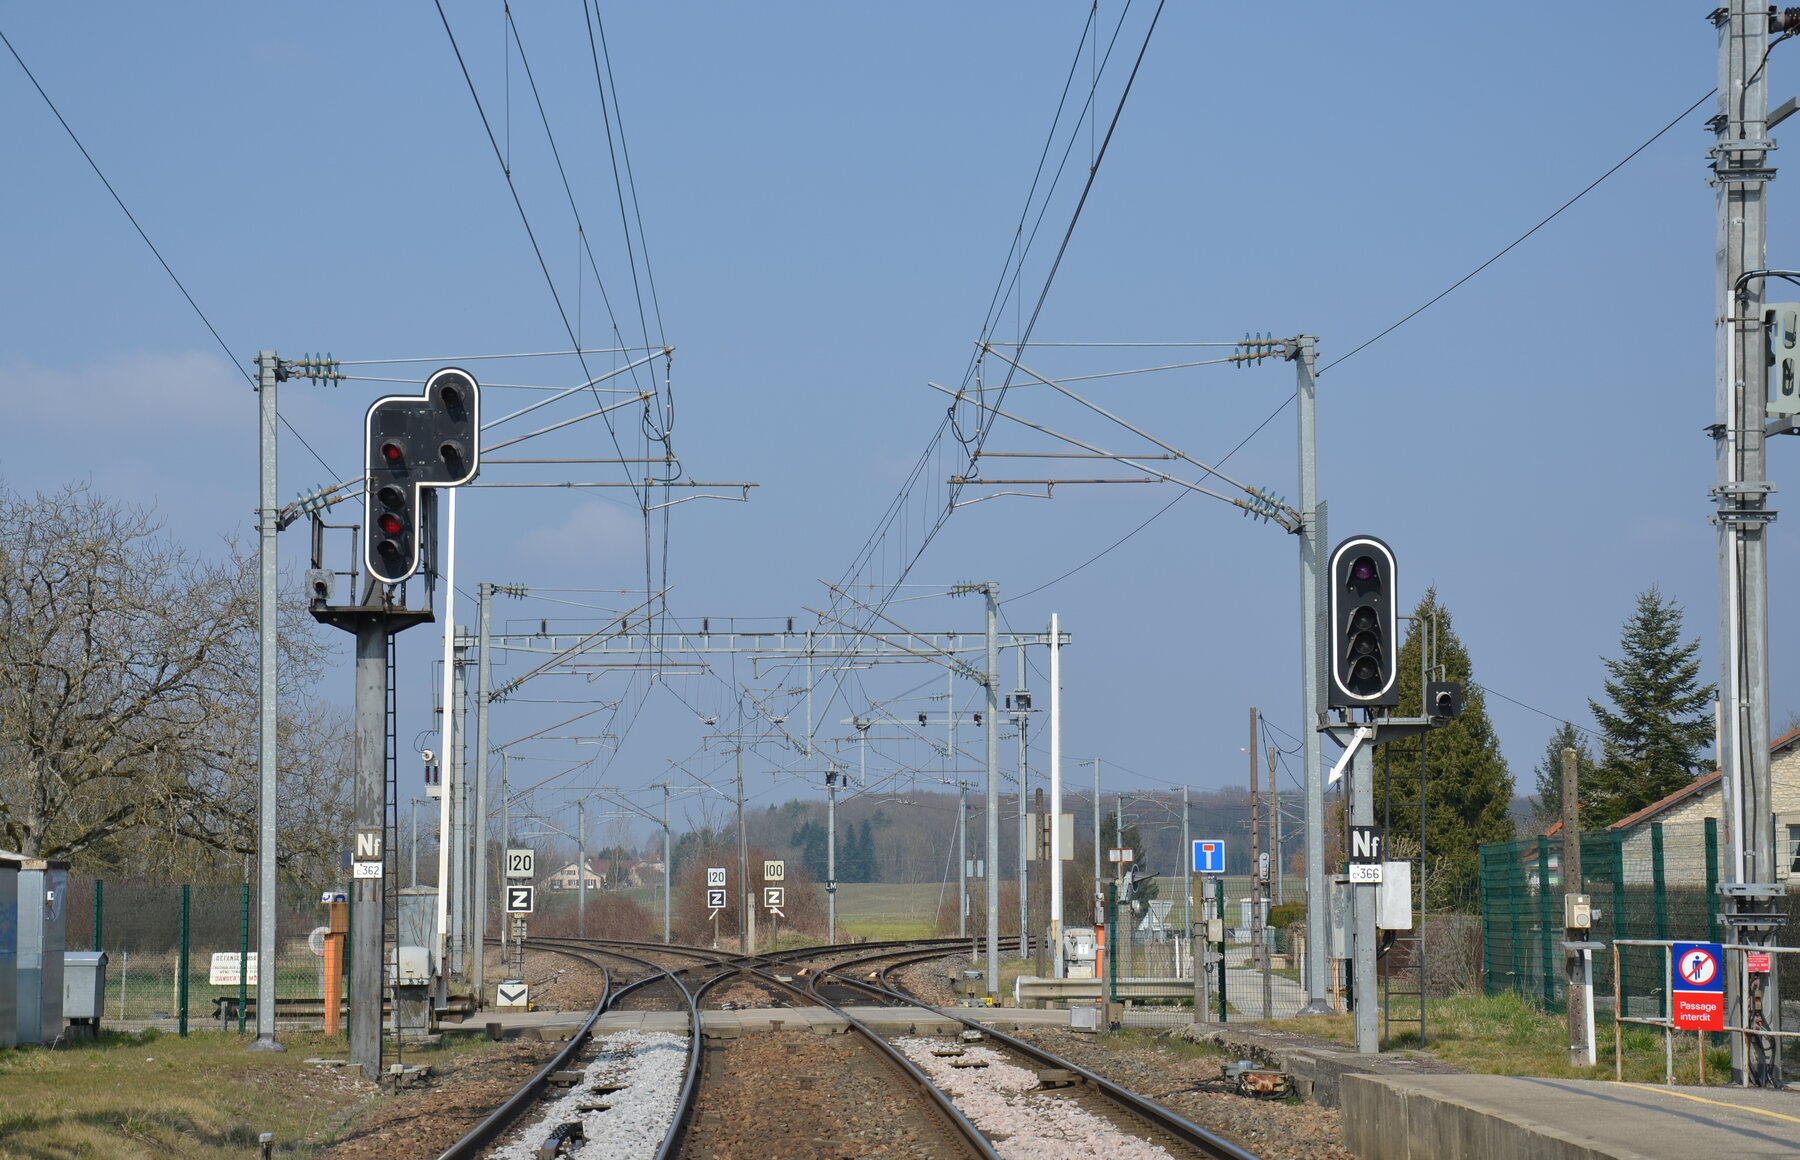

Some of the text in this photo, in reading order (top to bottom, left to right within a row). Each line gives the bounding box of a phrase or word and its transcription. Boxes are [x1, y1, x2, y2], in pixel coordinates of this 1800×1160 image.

[358, 833, 381, 856] Nf
[1353, 830, 1380, 857] Nf
[509, 855, 531, 871] 120
[709, 871, 724, 882] 120
[766, 865, 783, 877] 100
[512, 891, 527, 908] Z
[711, 893, 722, 904] Z
[768, 891, 780, 904] Z
[1680, 1001, 1717, 1012] Passage
[1680, 1013, 1711, 1021] interdit
